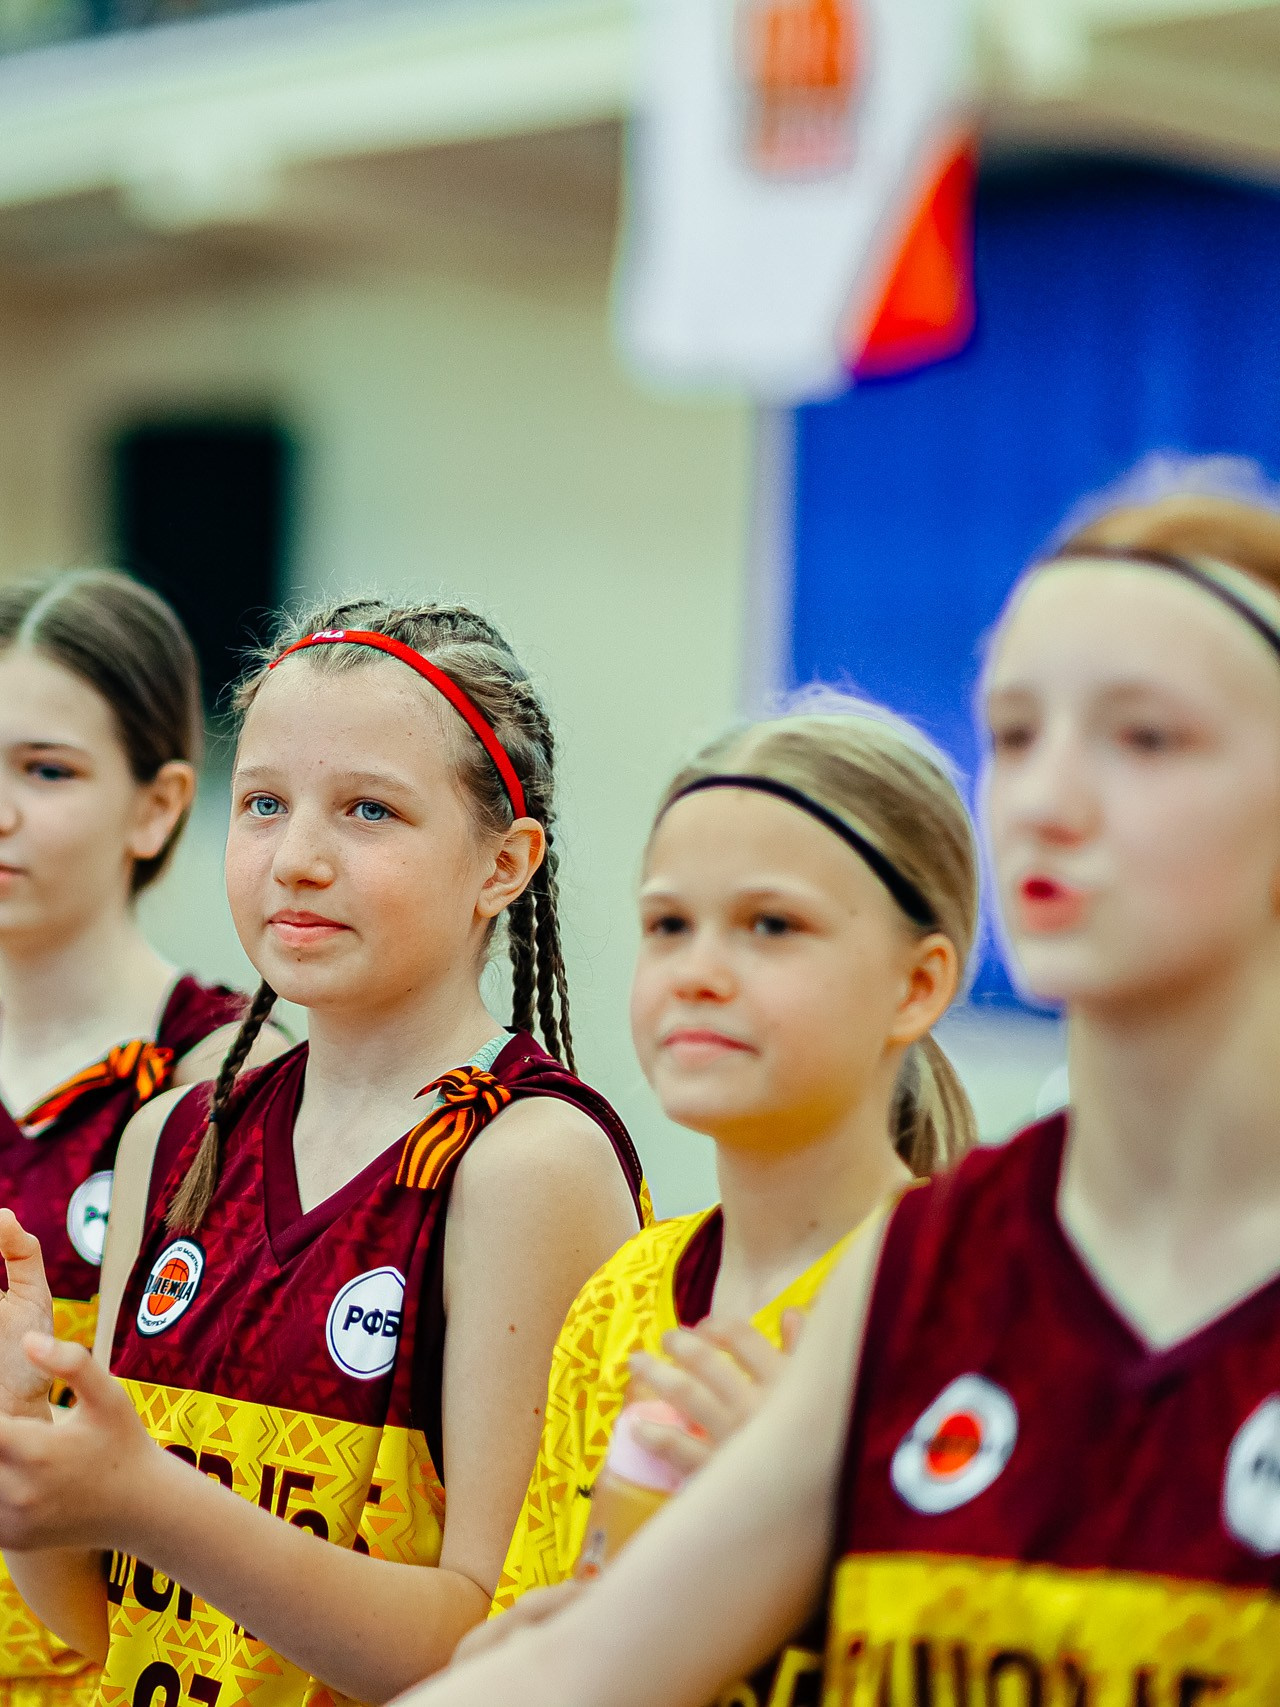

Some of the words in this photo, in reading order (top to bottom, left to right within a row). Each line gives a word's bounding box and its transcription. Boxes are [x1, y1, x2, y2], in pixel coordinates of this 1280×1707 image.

[311, 630, 345, 641] FILA
[143, 1273, 196, 1301] ДЕЖДА
[342, 1304, 401, 1338] РФБ
